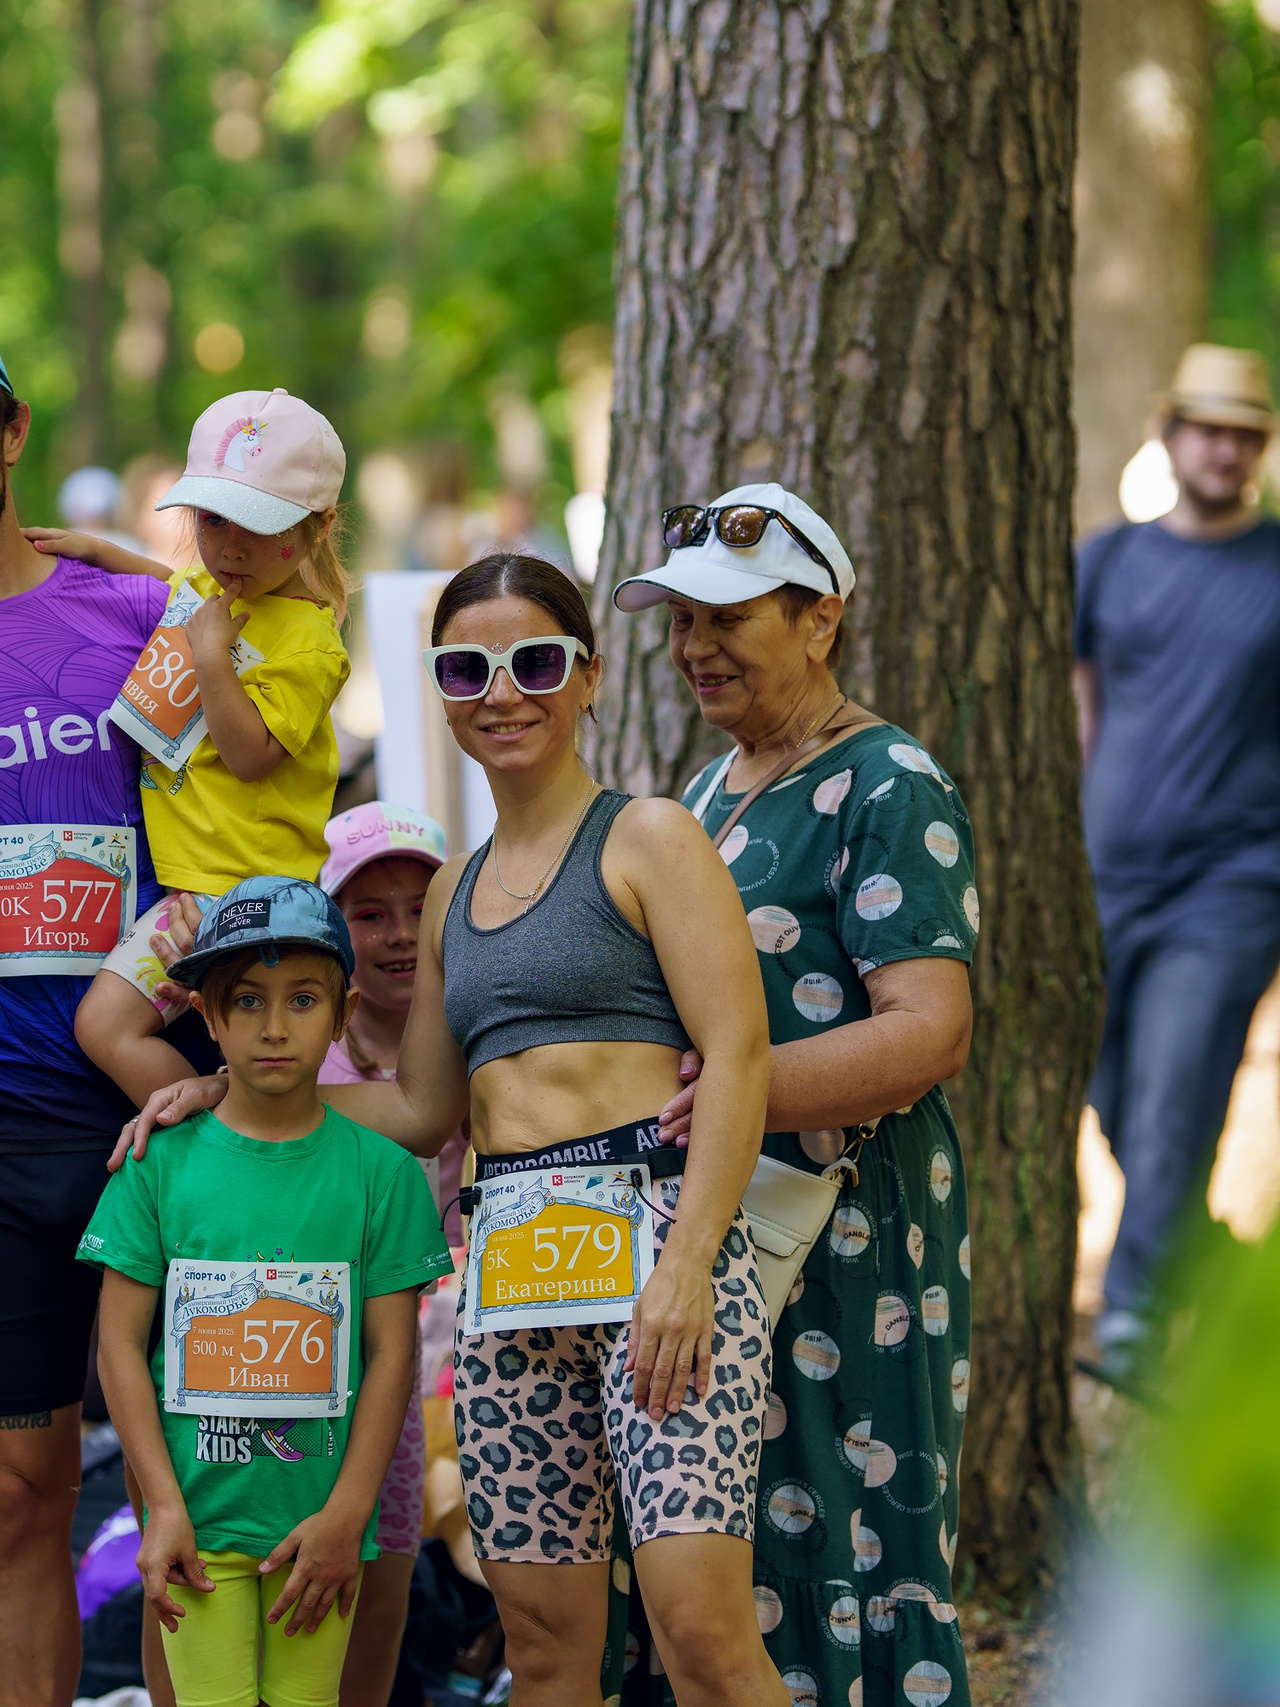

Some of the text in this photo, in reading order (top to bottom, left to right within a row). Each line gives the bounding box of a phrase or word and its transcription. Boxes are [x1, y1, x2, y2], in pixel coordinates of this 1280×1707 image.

[136, 635, 199, 707] 580
[11, 836, 24, 845] 40
[347, 820, 424, 845] SUNNY
[16, 882, 34, 890] 2025
[40, 879, 116, 923] 577
[222, 902, 264, 921] NEVER
[229, 918, 251, 929] NEVER
[23, 926, 89, 951] Игорь
[505, 1185, 515, 1194] 40
[532, 1223, 621, 1272] 579
[185, 1271, 226, 1282] СПОРТ 40
[496, 1277, 617, 1300] Екатерина
[182, 1297, 249, 1320] Лукоморье
[192, 1319, 325, 1365] 500 м 576
[217, 1328, 234, 1336] 2025
[228, 1366, 290, 1388] Иван
[196, 1431, 252, 1464] KIDS
